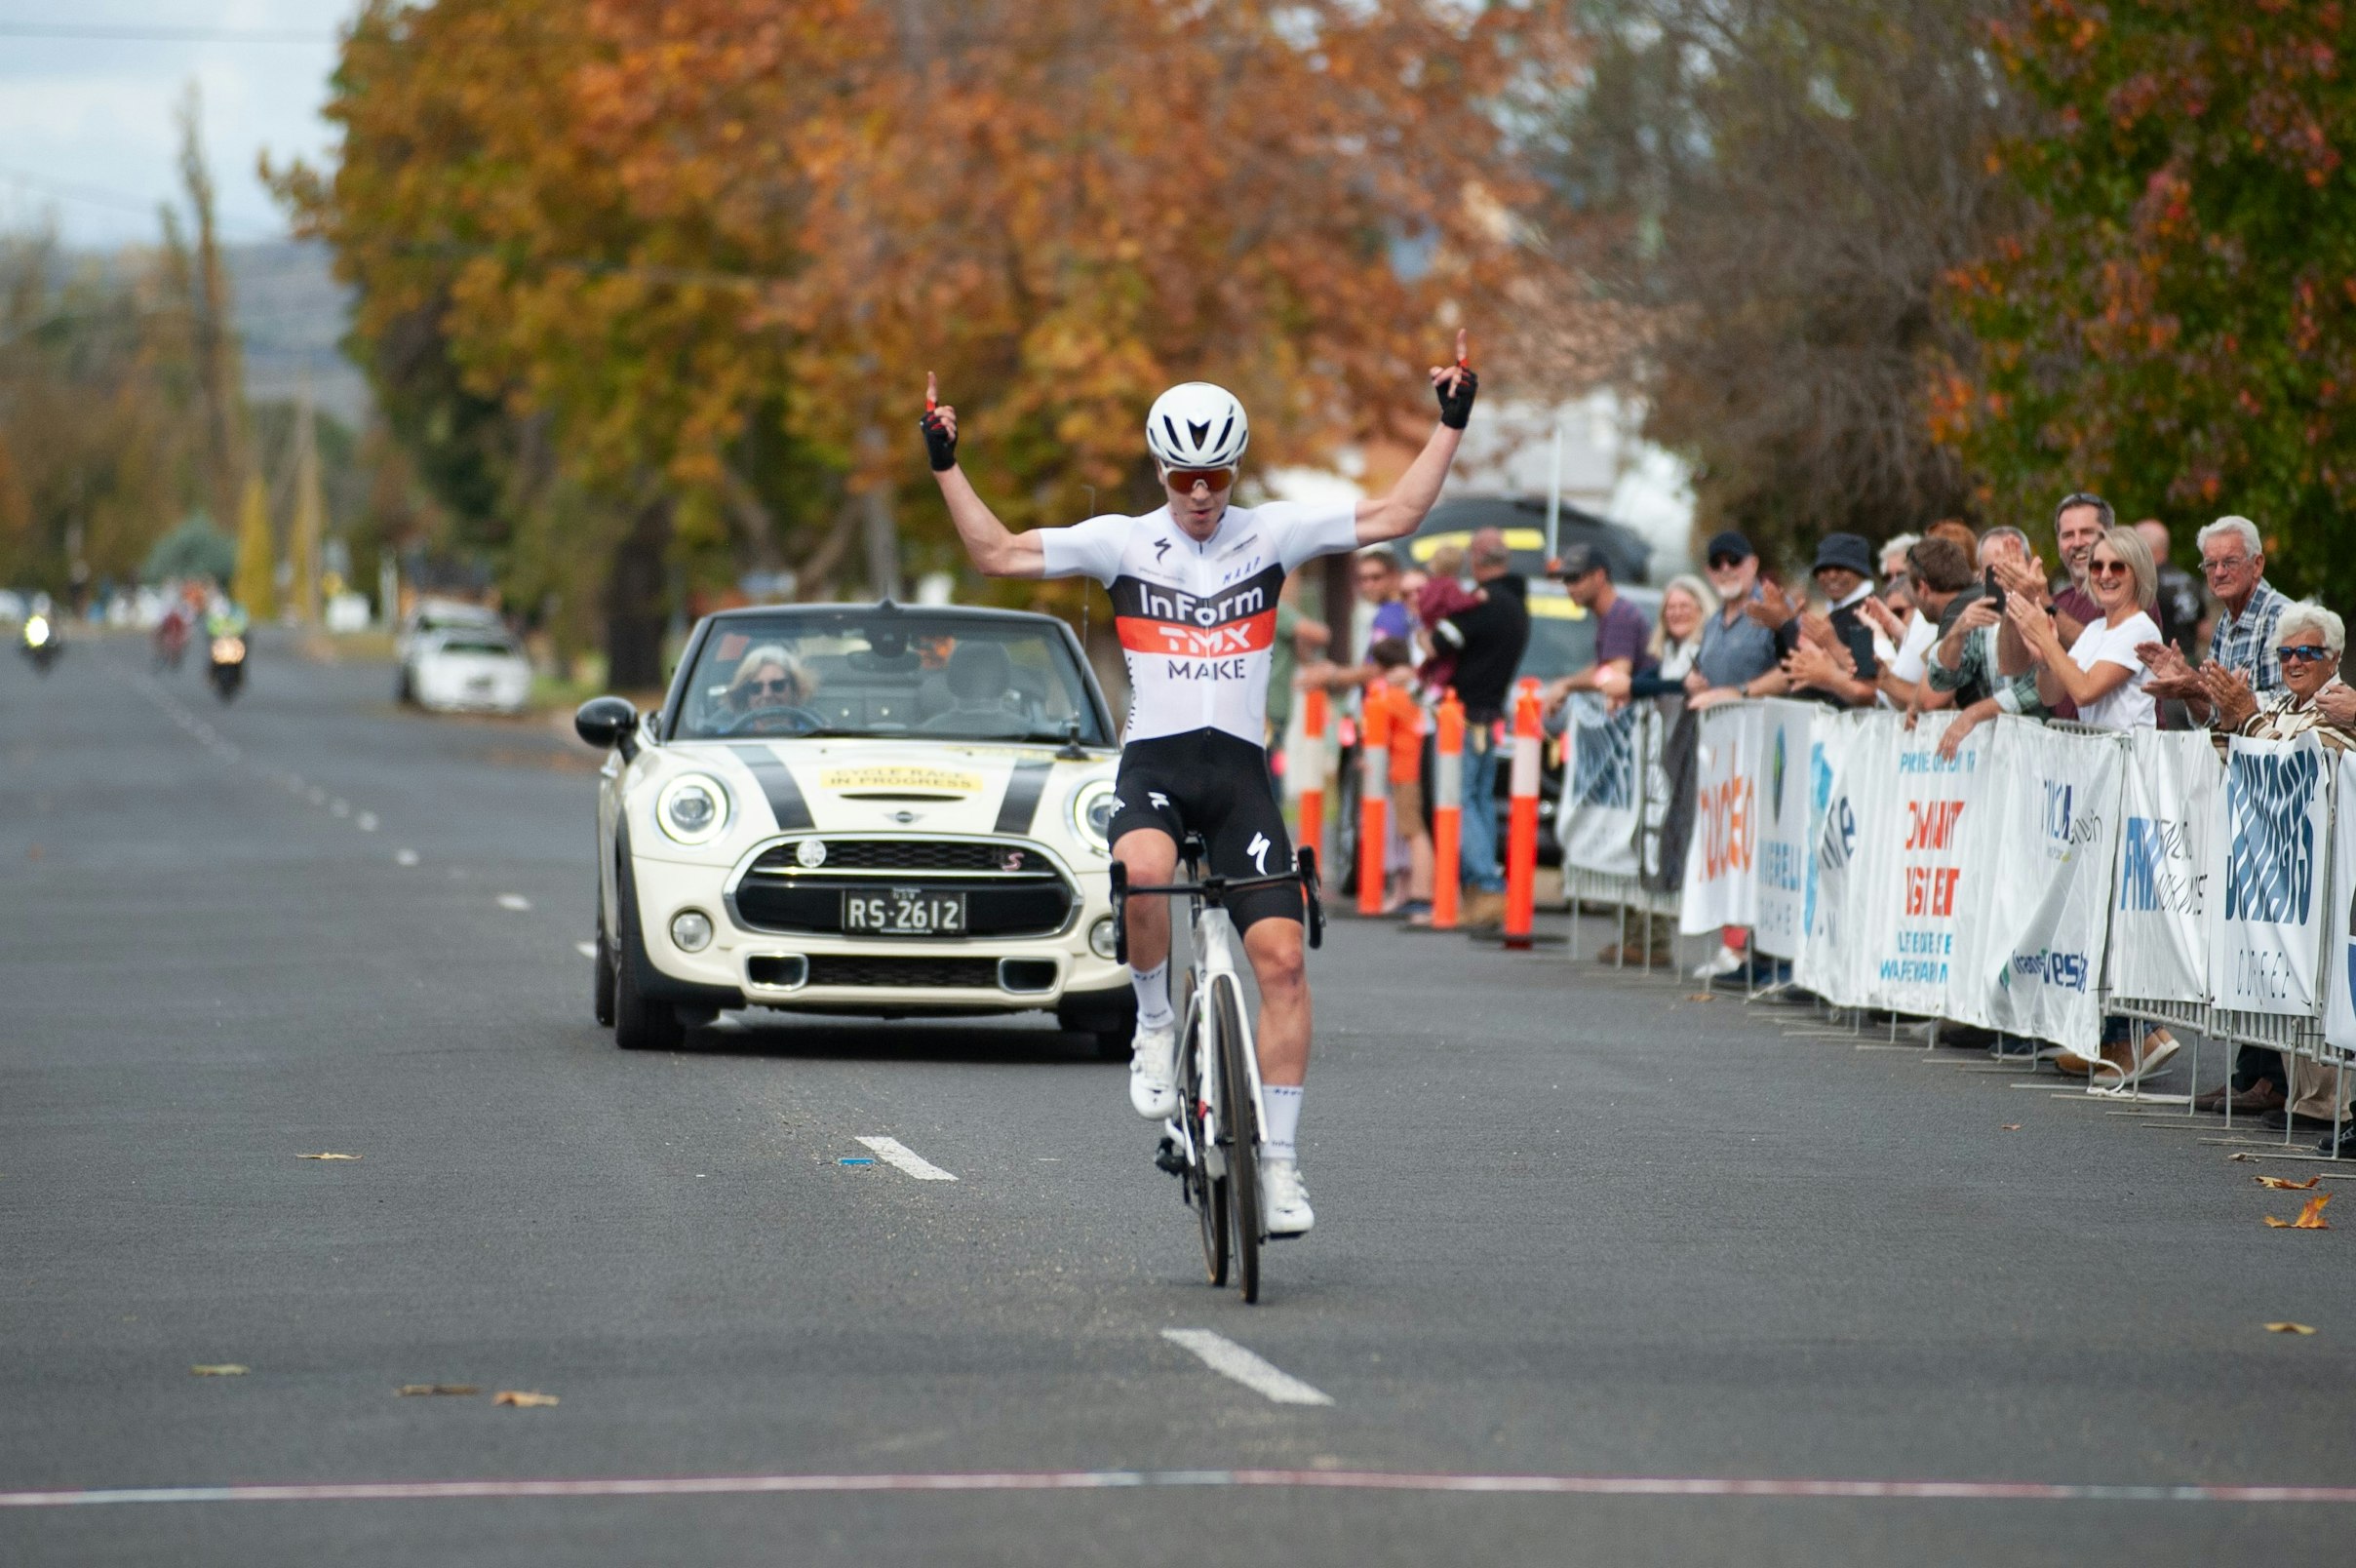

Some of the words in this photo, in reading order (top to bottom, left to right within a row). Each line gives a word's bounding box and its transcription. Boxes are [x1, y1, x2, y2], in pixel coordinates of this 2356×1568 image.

[1158, 622, 1251, 654] TMX
[1167, 658, 1246, 681] MAKE
[831, 777, 850, 786] IN
[859, 776, 972, 789] PROGRESS
[836, 767, 899, 778] CYCLE
[910, 768, 963, 780] RACE
